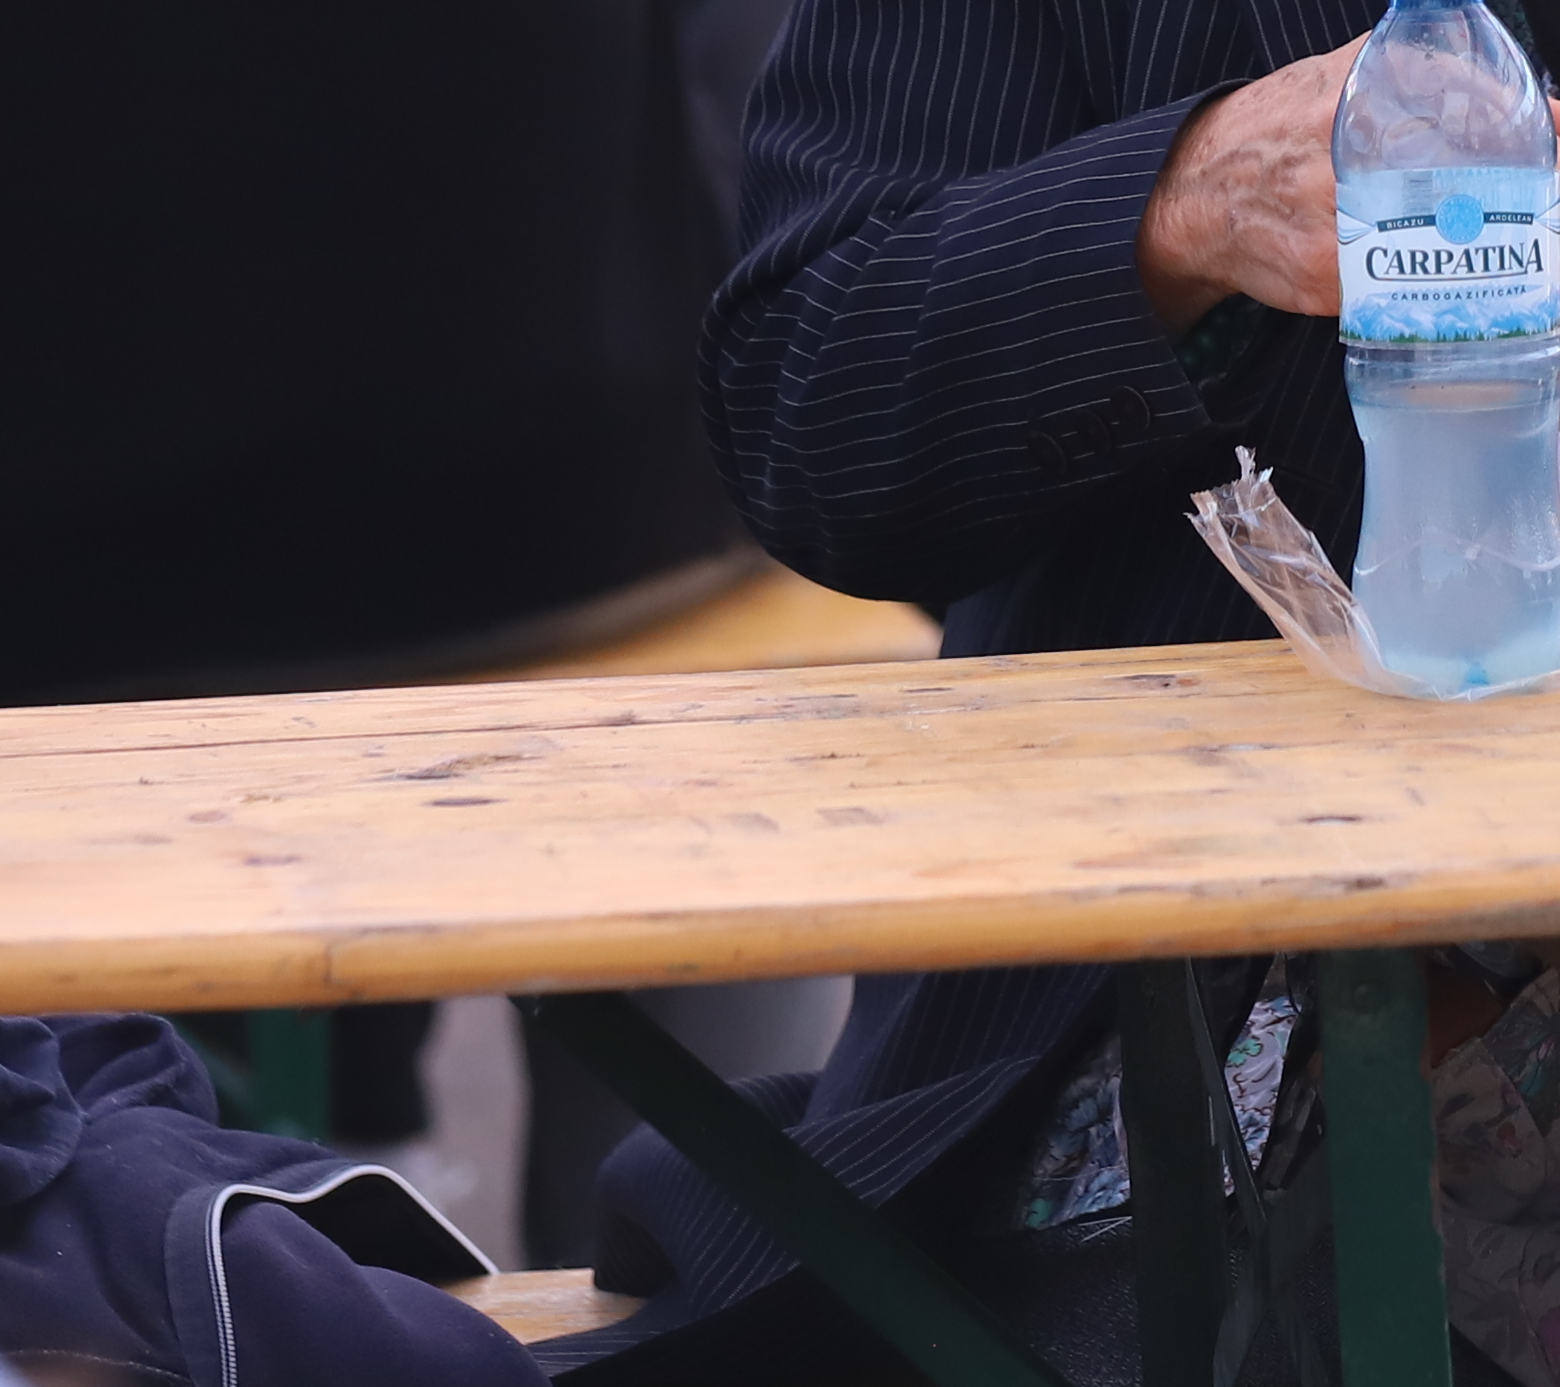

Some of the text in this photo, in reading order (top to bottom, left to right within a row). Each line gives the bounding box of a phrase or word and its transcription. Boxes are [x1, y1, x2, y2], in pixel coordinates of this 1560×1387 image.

[1386, 214, 1532, 229] BICAZU ARDELEAN
[1366, 238, 1544, 280] CARPATINA
